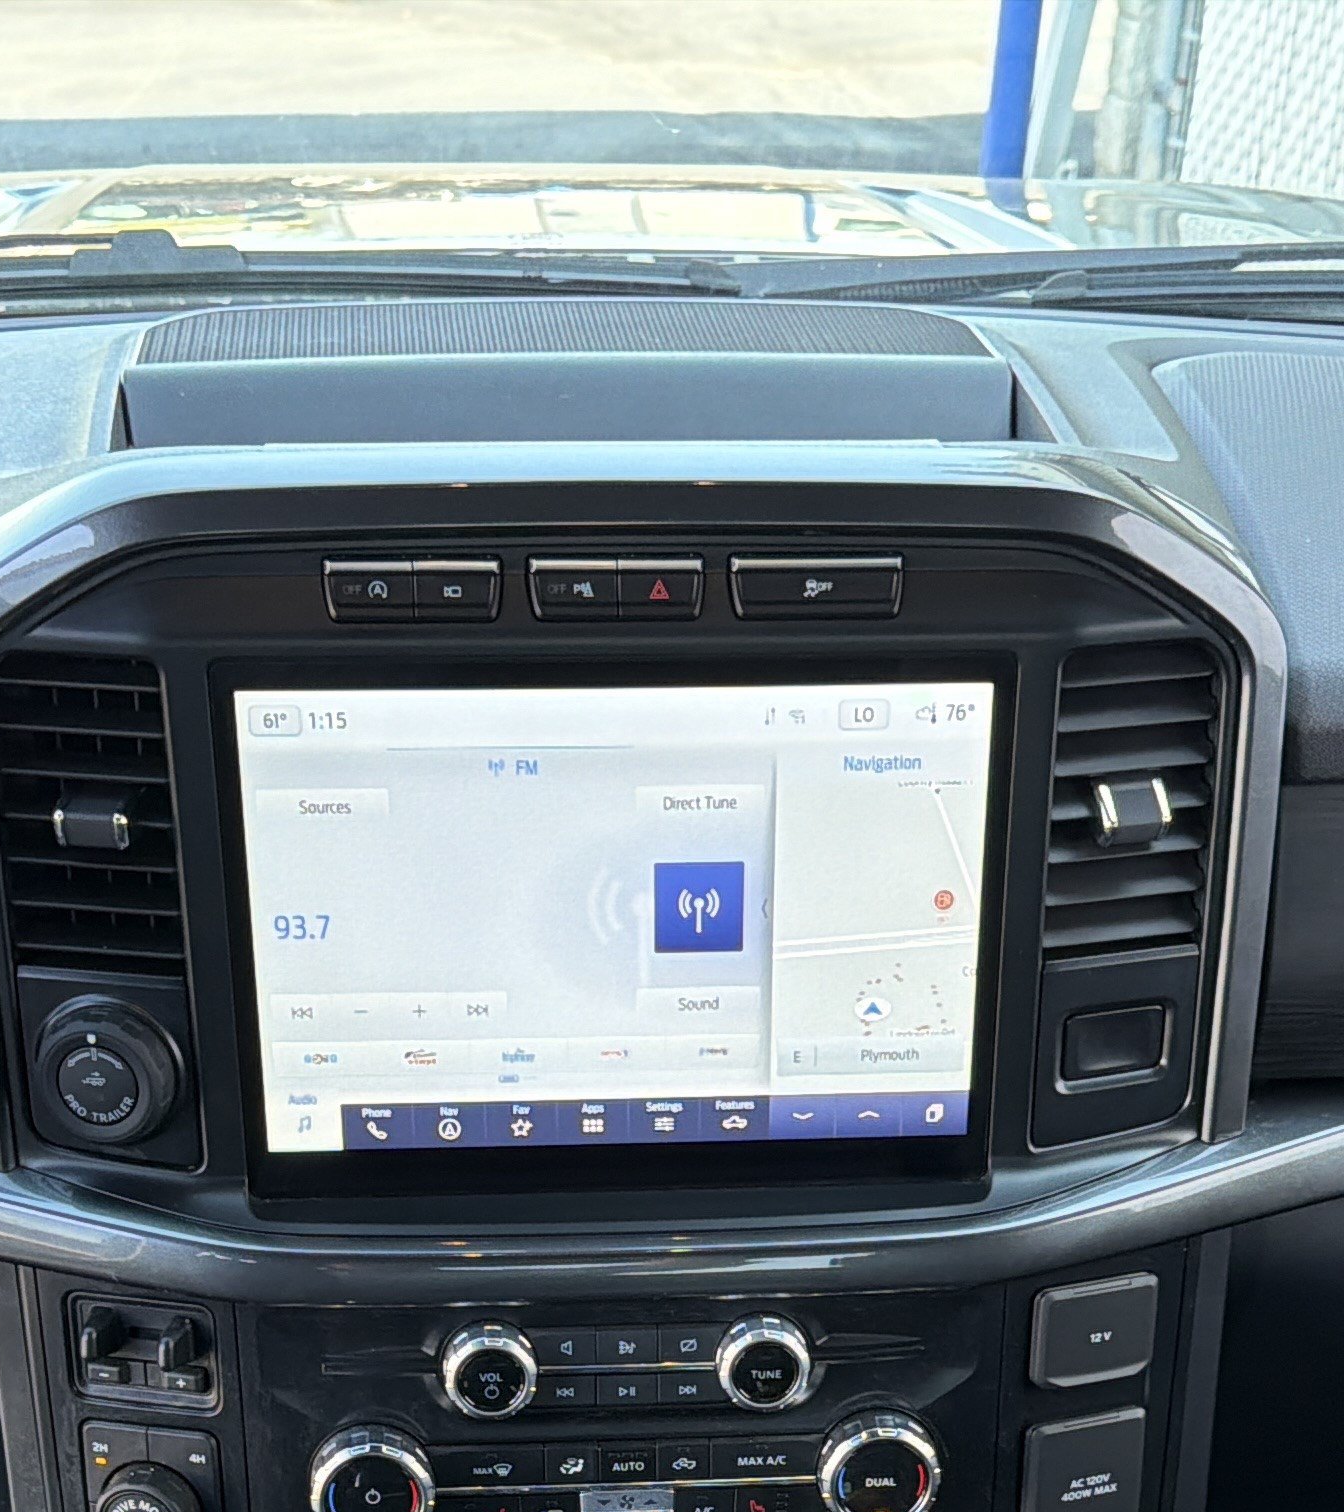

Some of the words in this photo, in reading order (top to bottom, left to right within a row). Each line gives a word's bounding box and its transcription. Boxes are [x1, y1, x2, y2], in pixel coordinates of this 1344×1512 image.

[308, 711, 347, 730] 1:15
[854, 707, 875, 723] LO
[515, 759, 538, 776] FM
[843, 754, 922, 773] Navigation
[298, 800, 352, 815] Sources
[662, 795, 702, 811] Direct
[704, 795, 738, 811] Tune
[273, 914, 330, 940] 93.7
[678, 997, 719, 1012] Sound
[860, 1048, 920, 1064] Plymouth
[64, 1094, 87, 1117] PRO
[91, 1096, 136, 1123] TRAILER
[362, 1108, 392, 1119] Phone
[439, 1106, 459, 1117] Nav
[512, 1105, 530, 1115] Fav
[581, 1103, 605, 1115] Apps
[645, 1101, 684, 1114] Settings
[715, 1100, 755, 1112] Features
[479, 1373, 503, 1383] VOL
[751, 1369, 782, 1380] TUNE
[189, 1454, 206, 1464] 4H
[612, 1461, 645, 1472] AUTO
[737, 1456, 764, 1466] MAX
[765, 1455, 787, 1466] A/C
[865, 1476, 897, 1488] DUAL
[1070, 1478, 1085, 1489] AC
[1085, 1473, 1111, 1487] 120V
[1061, 1488, 1092, 1502] 400W
[1094, 1483, 1118, 1496] MAX
